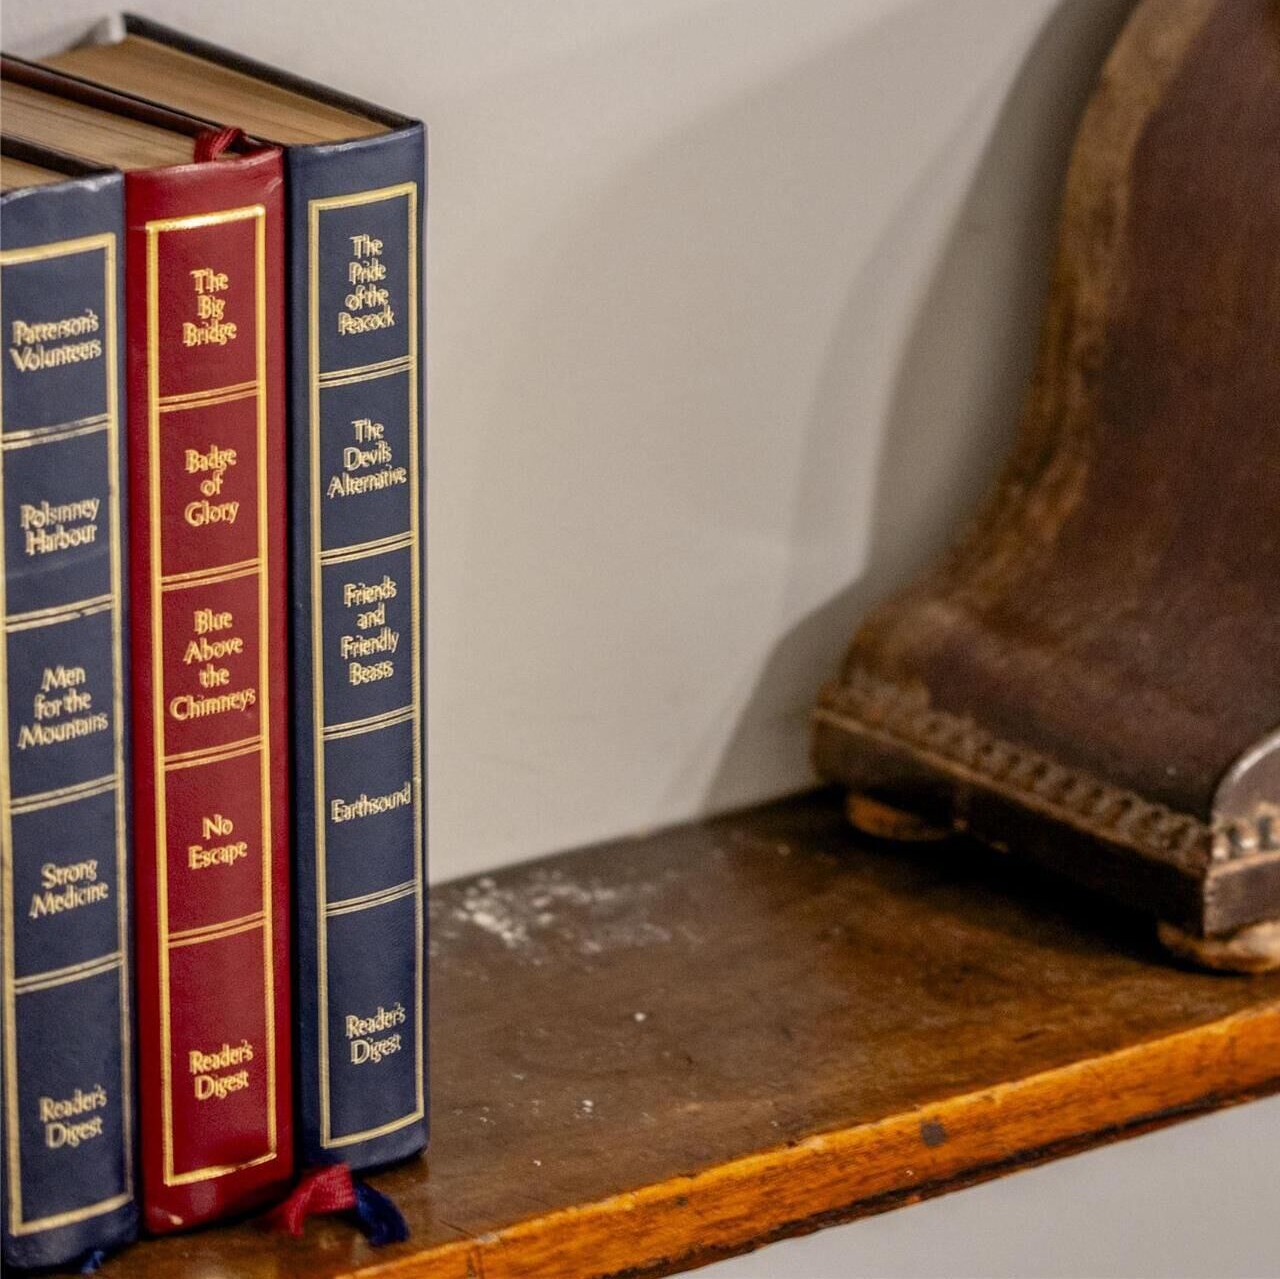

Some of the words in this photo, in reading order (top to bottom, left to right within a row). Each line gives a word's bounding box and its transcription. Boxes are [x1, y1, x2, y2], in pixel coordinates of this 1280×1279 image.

[349, 233, 383, 259] The
[189, 267, 229, 294] The
[348, 257, 387, 286] Pride
[197, 294, 225, 321] Big
[345, 284, 365, 311] of
[362, 283, 389, 307] the
[12, 308, 99, 345] Patterson's
[182, 318, 238, 348] Bridge
[337, 304, 396, 336] Peacock
[9, 339, 102, 373] Volunteers
[351, 418, 385, 443] The
[184, 444, 238, 474] Badge
[343, 440, 393, 472] Devil's
[200, 468, 224, 497] of
[327, 463, 408, 500] Alternative
[20, 497, 100, 530] Polsinney
[184, 499, 240, 528] Glory
[26, 522, 98, 556] Harbour
[343, 574, 397, 608] Friends
[194, 608, 233, 635] Blue
[356, 602, 386, 630] and
[183, 636, 244, 665] Above
[340, 626, 400, 660] Friendly
[41, 665, 86, 692] Men
[199, 661, 231, 689] the
[349, 660, 394, 686] Beasts
[34, 694, 63, 721] for
[63, 688, 92, 713] the
[169, 687, 257, 721] Chimneys
[18, 712, 109, 750] Mountains
[330, 781, 412, 823] Earthsound
[202, 813, 234, 841] No
[188, 841, 248, 870] Escape
[41, 859, 99, 890] Strong
[28, 880, 109, 919] Medicine
[345, 1002, 407, 1039] Reader's
[189, 1039, 254, 1074] Reader's
[350, 1032, 402, 1065] Digest
[194, 1069, 250, 1101] Digest
[39, 1083, 108, 1123] Reader's
[45, 1115, 104, 1149] Digest
